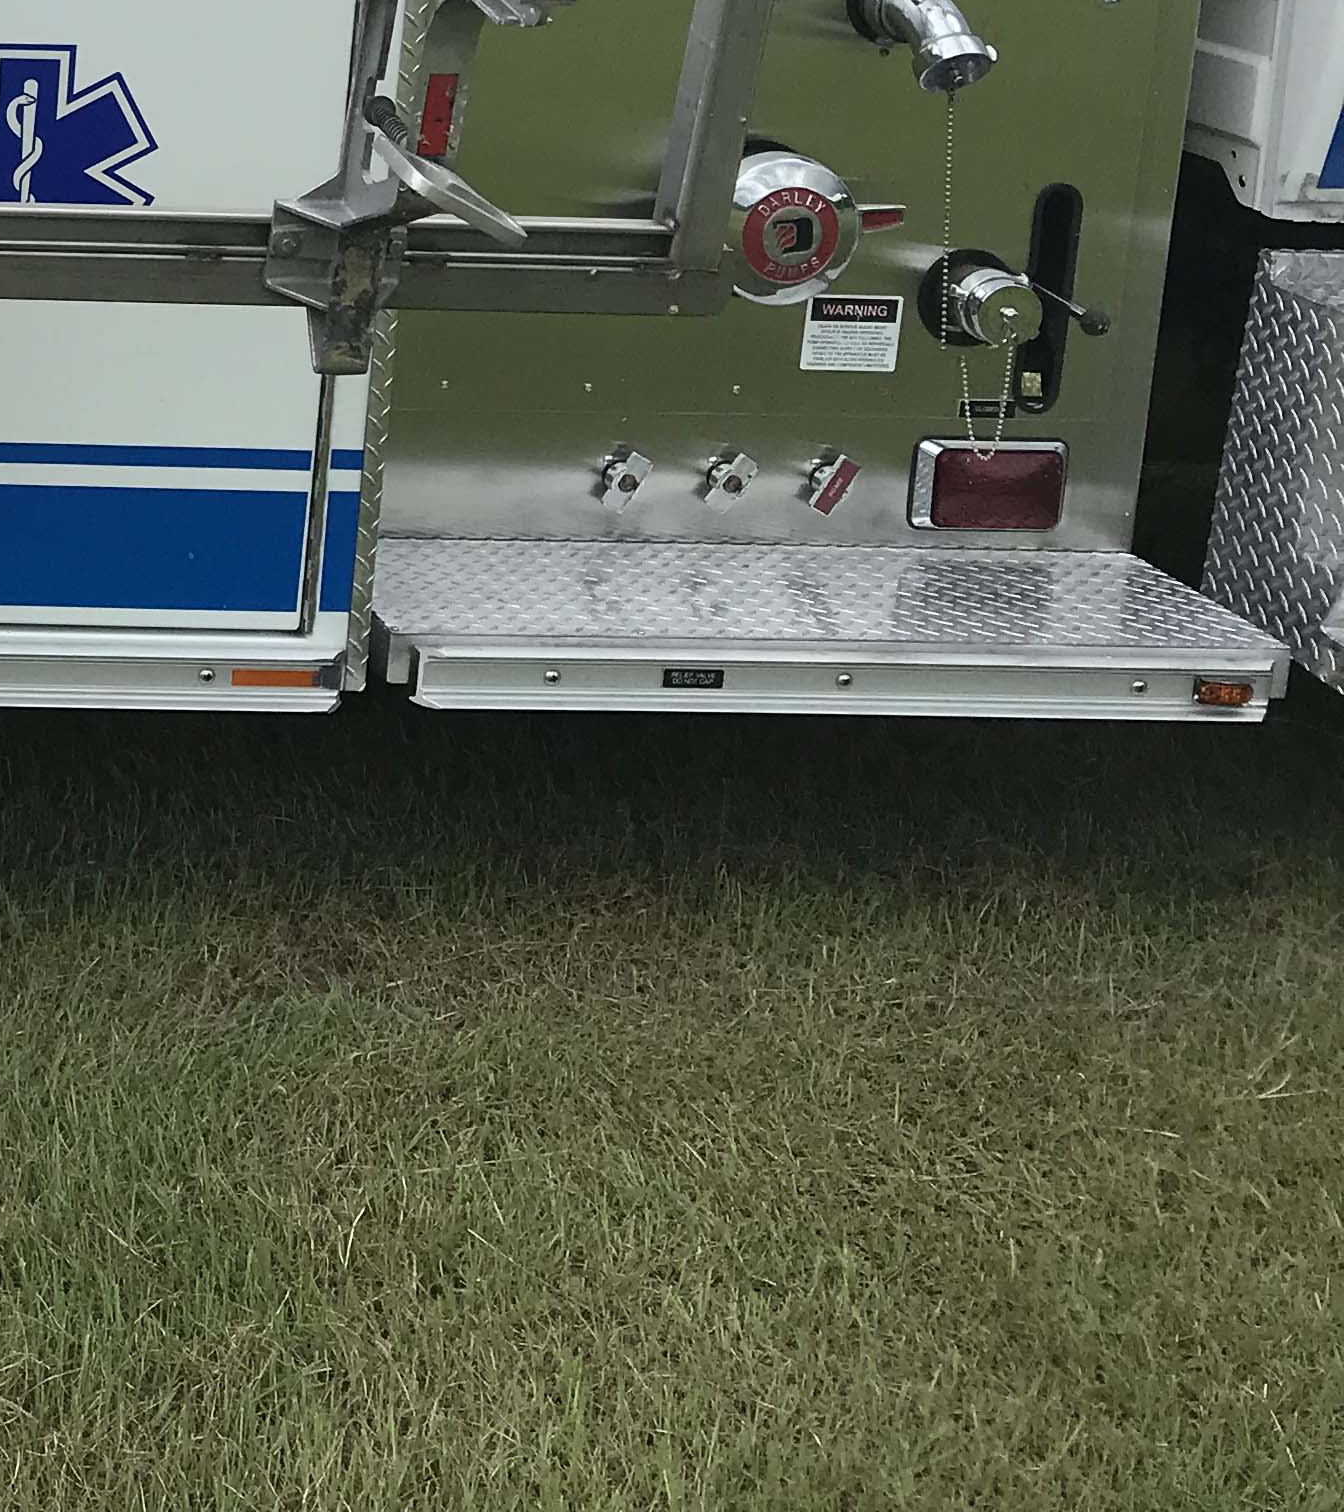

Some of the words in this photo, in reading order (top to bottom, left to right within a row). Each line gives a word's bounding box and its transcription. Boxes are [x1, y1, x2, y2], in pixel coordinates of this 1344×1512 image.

[758, 191, 827, 217] DARLEY
[763, 256, 820, 279] PUMPS
[822, 303, 888, 317] WARNING
